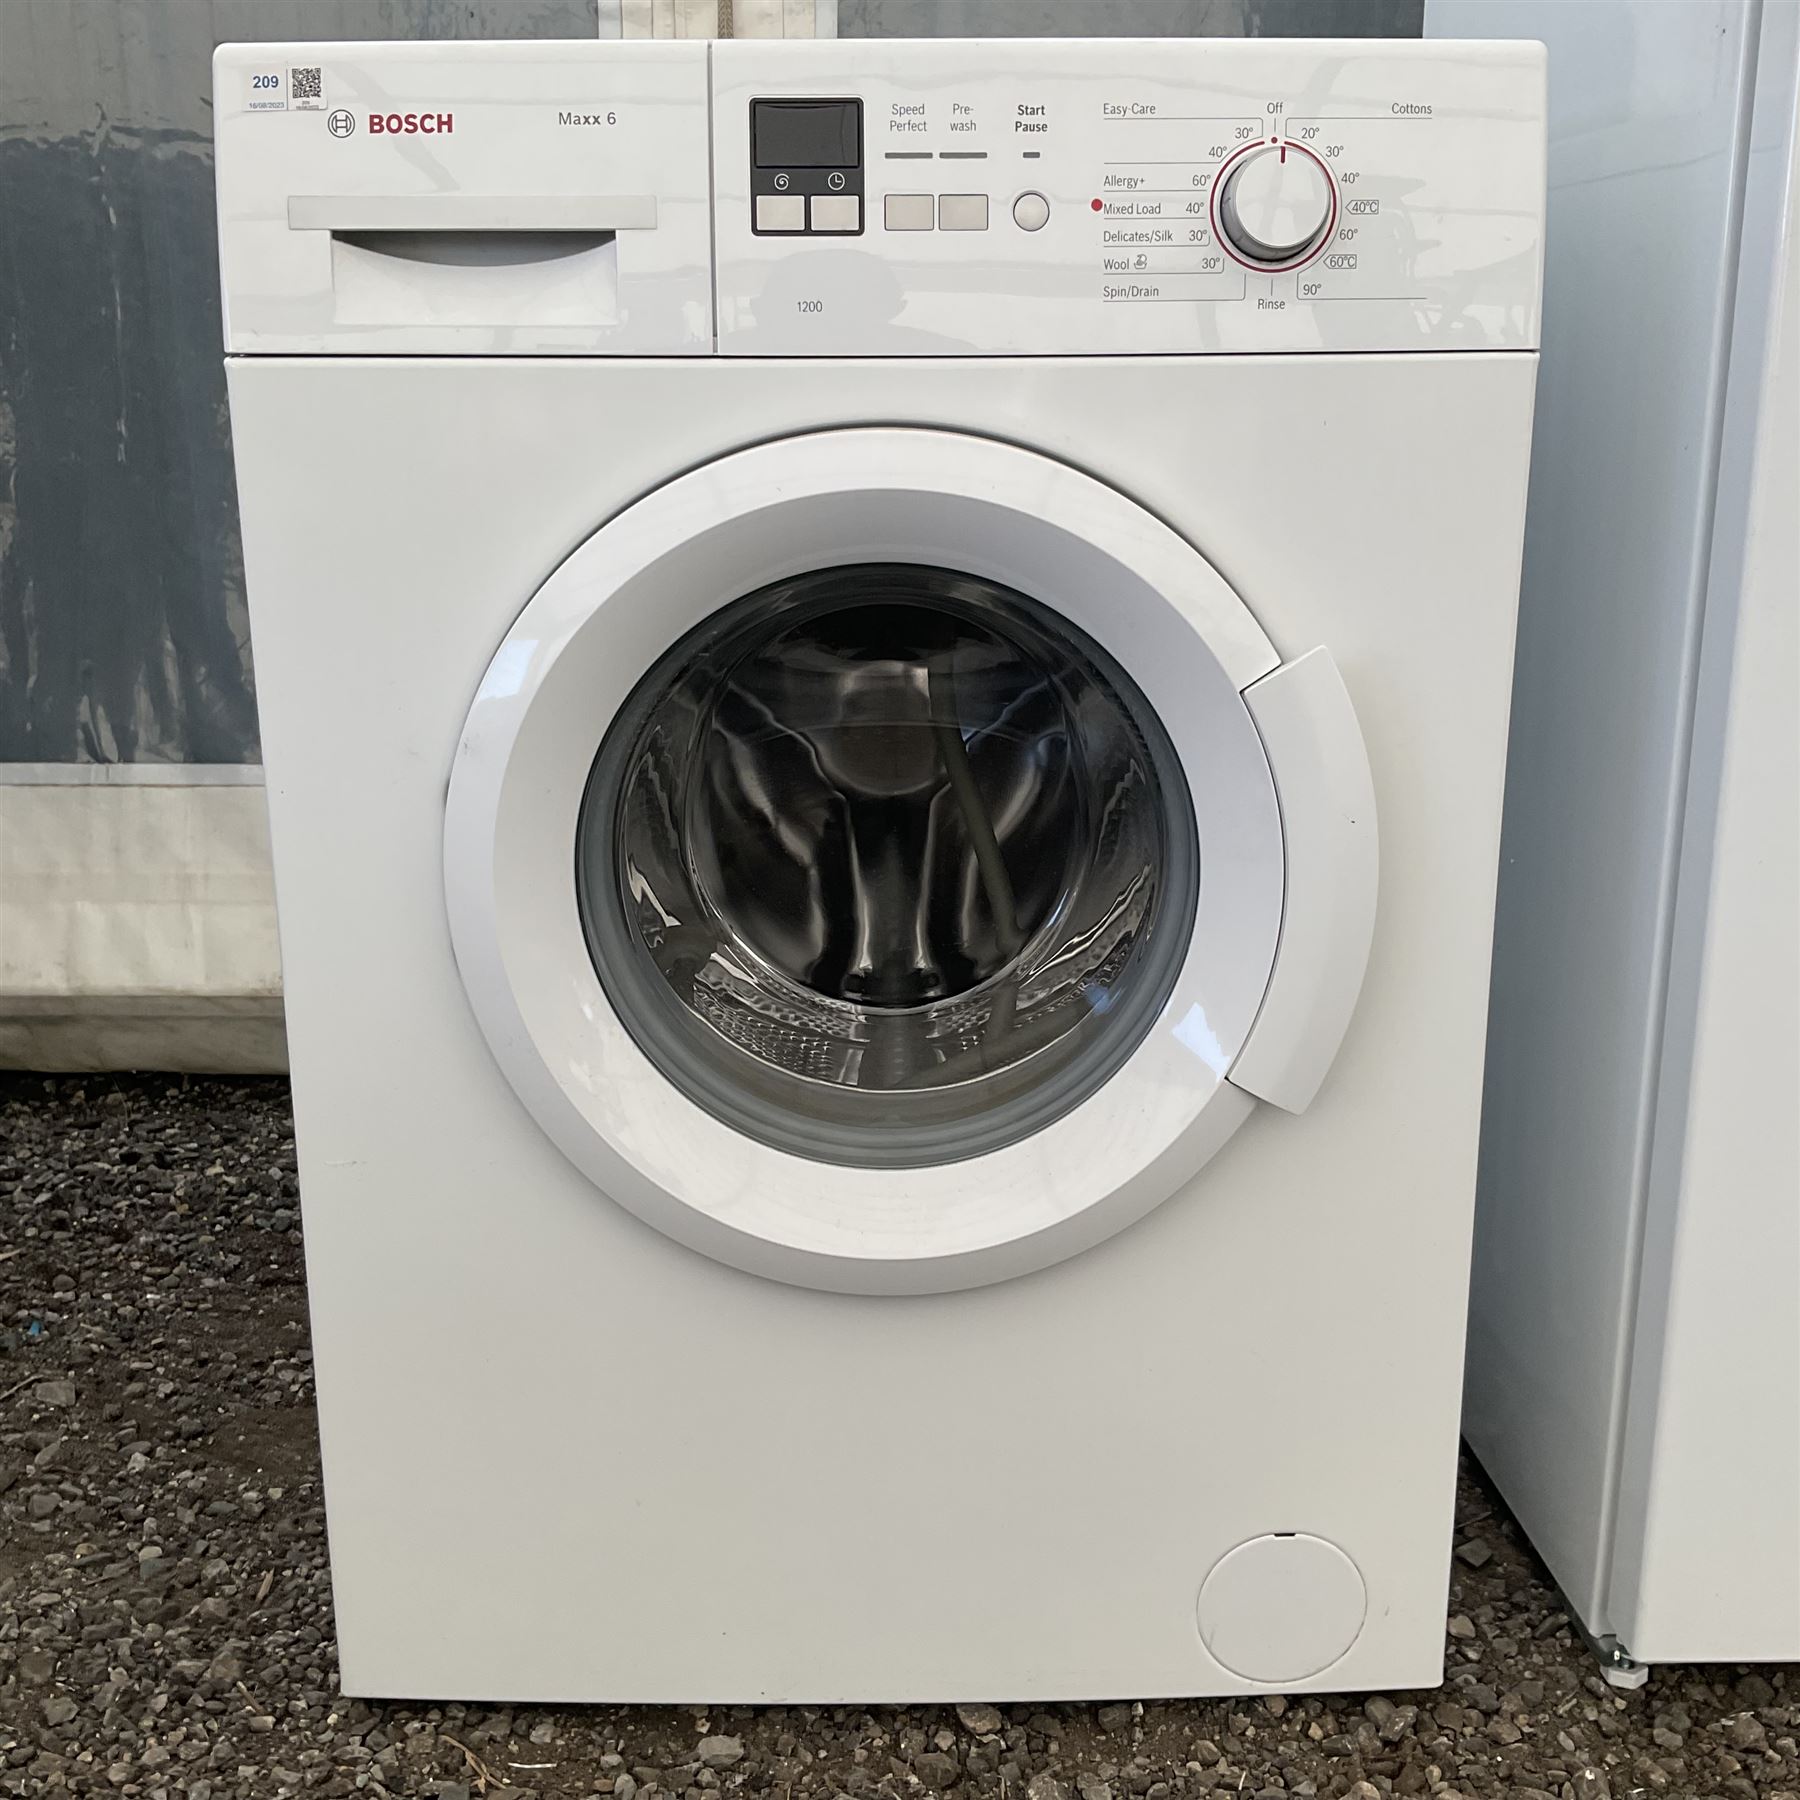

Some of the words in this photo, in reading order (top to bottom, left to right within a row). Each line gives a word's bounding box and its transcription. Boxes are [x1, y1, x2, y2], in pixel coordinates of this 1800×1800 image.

[253, 75, 279, 88] 209
[891, 103, 925, 117] Speed
[952, 103, 974, 115] Pre-
[1017, 104, 1045, 116] Start
[1267, 102, 1283, 114] Off
[1391, 103, 1433, 114] Cottons
[369, 114, 453, 134] BOSCH
[558, 112, 601, 126] Maxx
[607, 112, 617, 126] 6
[889, 119, 927, 132] Perfect
[949, 120, 977, 132] wash
[1015, 121, 1048, 132] Pause
[1234, 127, 1254, 139] 30°
[1301, 127, 1320, 139] 20°
[1208, 146, 1228, 158] 40°
[1325, 146, 1344, 157] 30°
[1103, 175, 1145, 189] Allergy+
[1192, 174, 1211, 186] 60°
[1341, 173, 1360, 184] 40°
[1103, 203, 1134, 214] Mixed
[1136, 202, 1161, 214] Load
[1185, 202, 1205, 214] 40°
[1351, 201, 1378, 213] 40°C
[1103, 230, 1173, 242] Delicates/Silk
[1189, 230, 1208, 241] 30°
[1339, 228, 1358, 240] 60°
[1103, 258, 1129, 270] Wool
[1201, 257, 1221, 269] 30°
[1329, 256, 1355, 268] 60°C
[1103, 285, 1159, 299] Spin/Drain
[1303, 283, 1321, 295] 90°
[797, 300, 823, 313] 1200
[1257, 298, 1286, 310] Rinse
